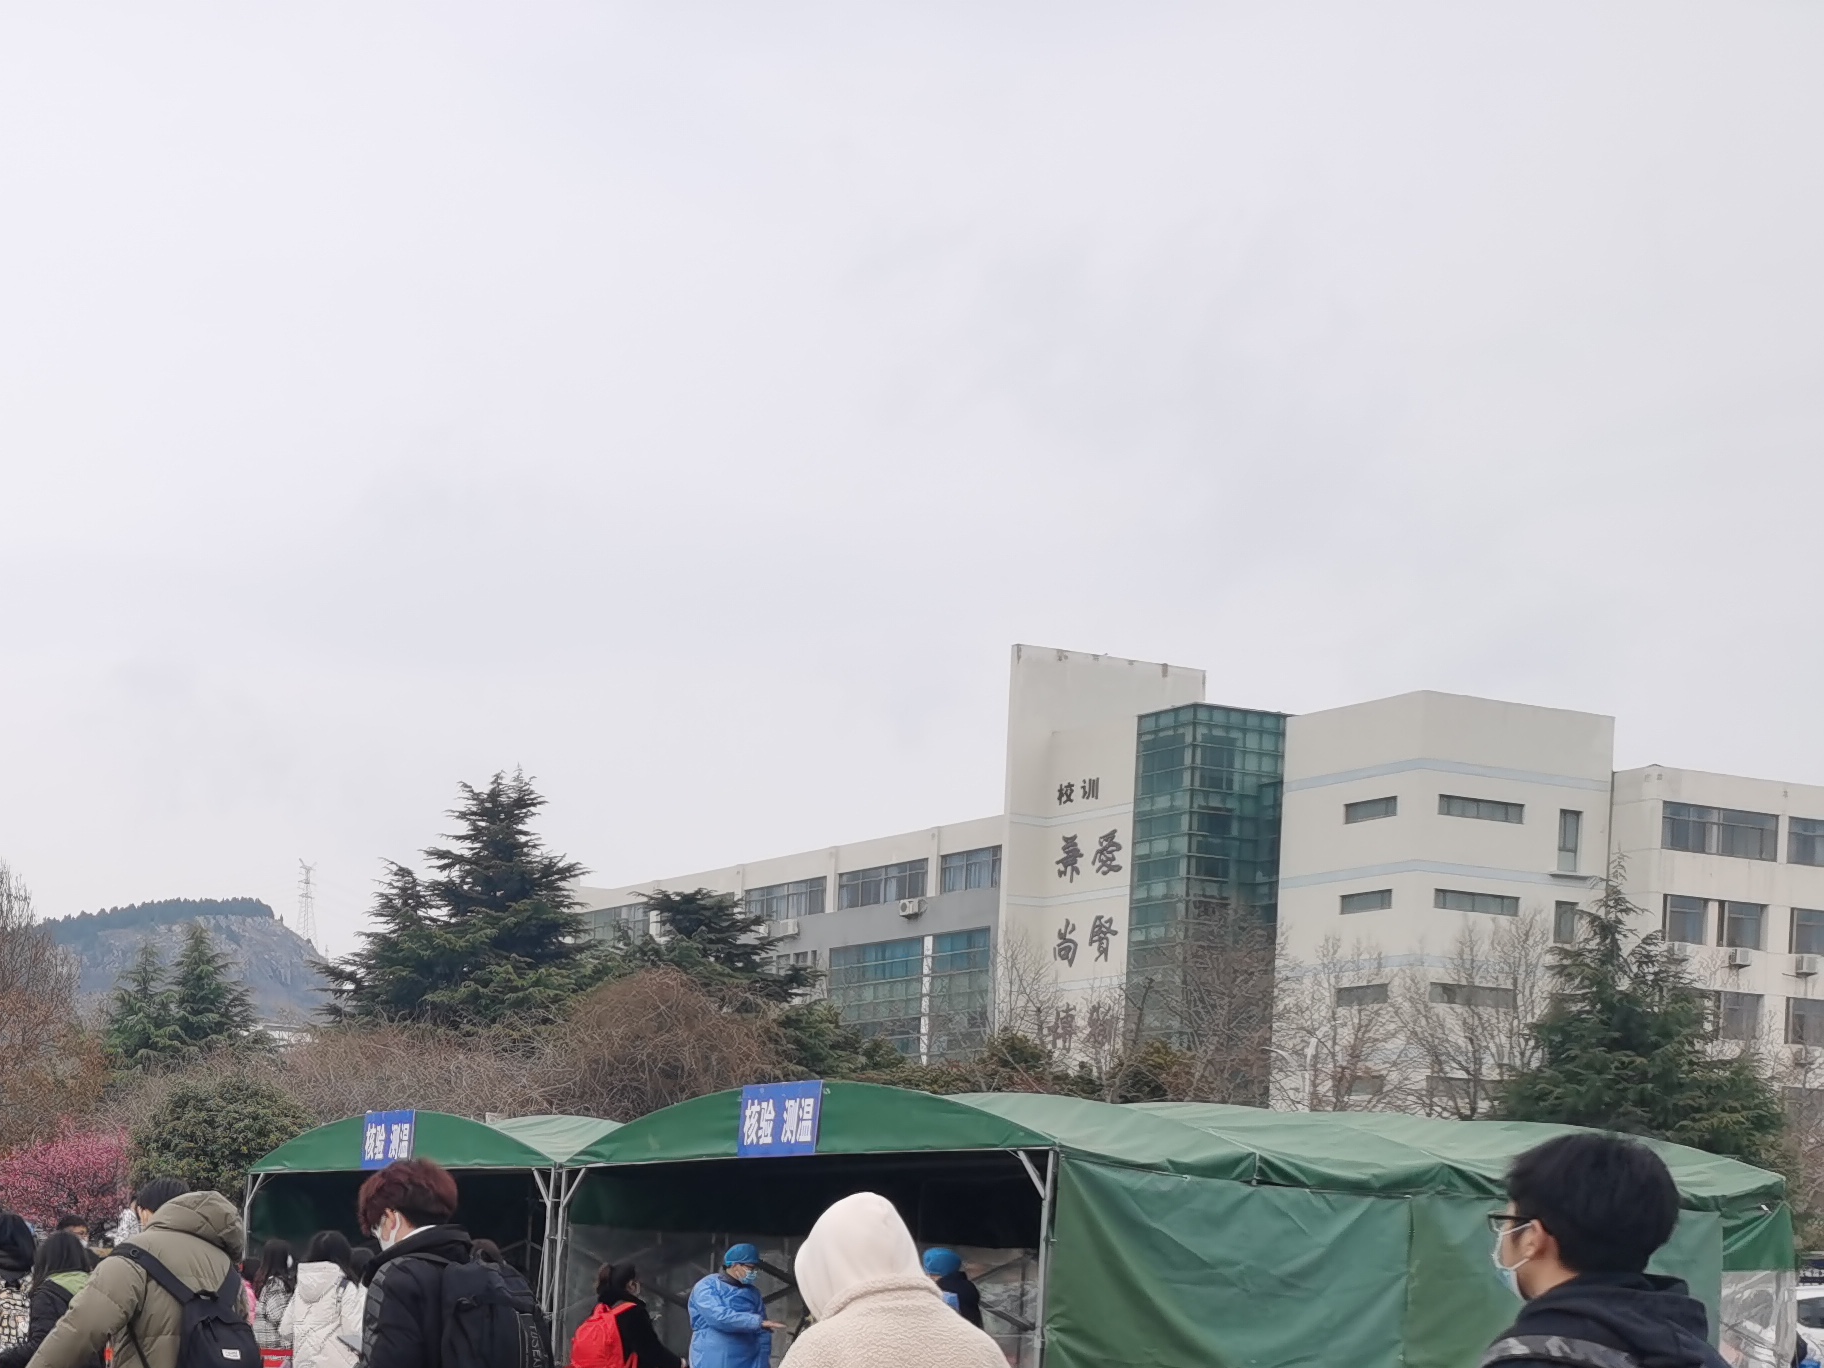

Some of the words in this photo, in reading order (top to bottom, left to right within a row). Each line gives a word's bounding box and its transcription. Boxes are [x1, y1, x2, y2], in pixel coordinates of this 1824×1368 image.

[1057, 777, 1100, 806] 校训
[743, 1098, 776, 1146] 核验
[781, 1097, 815, 1144] 测温
